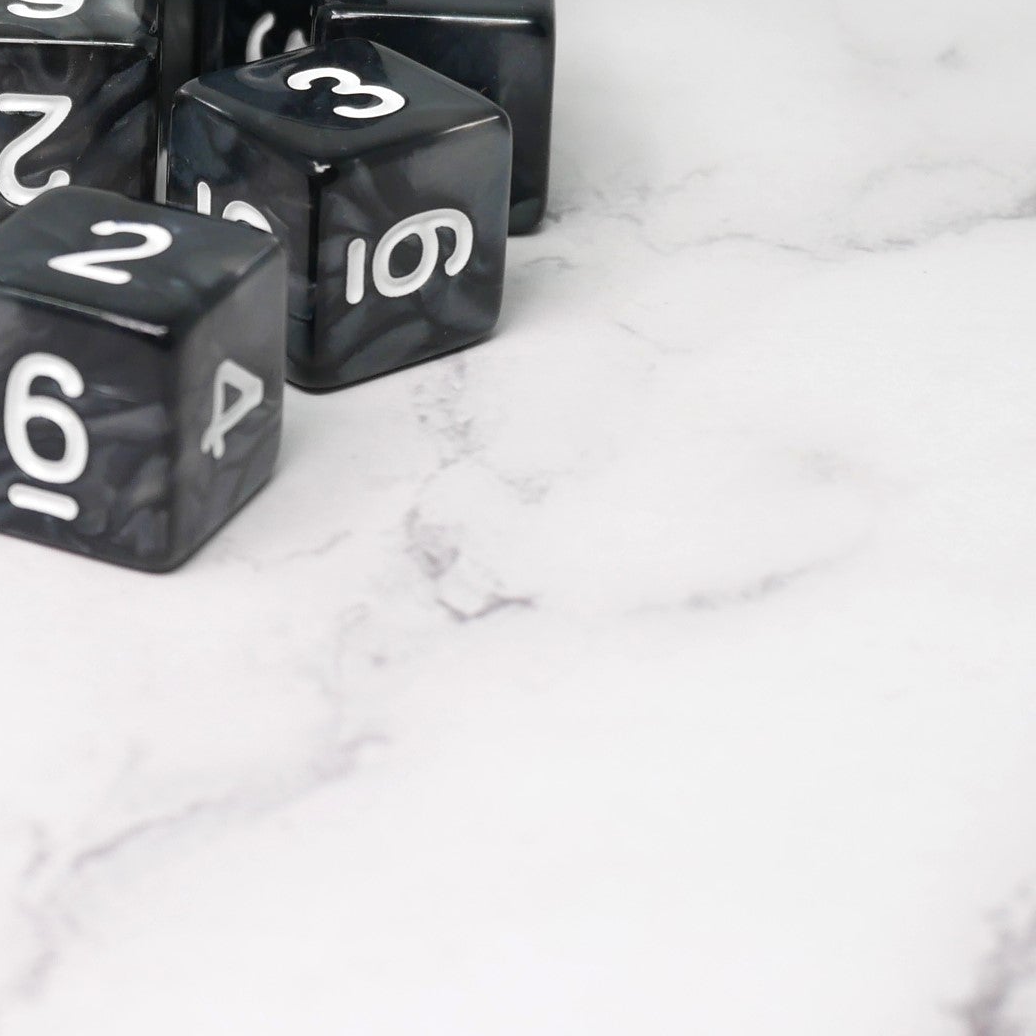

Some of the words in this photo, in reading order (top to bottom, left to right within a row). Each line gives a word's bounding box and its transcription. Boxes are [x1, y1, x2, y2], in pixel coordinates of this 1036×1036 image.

[286, 66, 406, 120] 3
[47, 220, 173, 285] 2
[346, 207, 475, 305] 6
[3, 352, 89, 522] 6
[200, 359, 265, 460] 4
